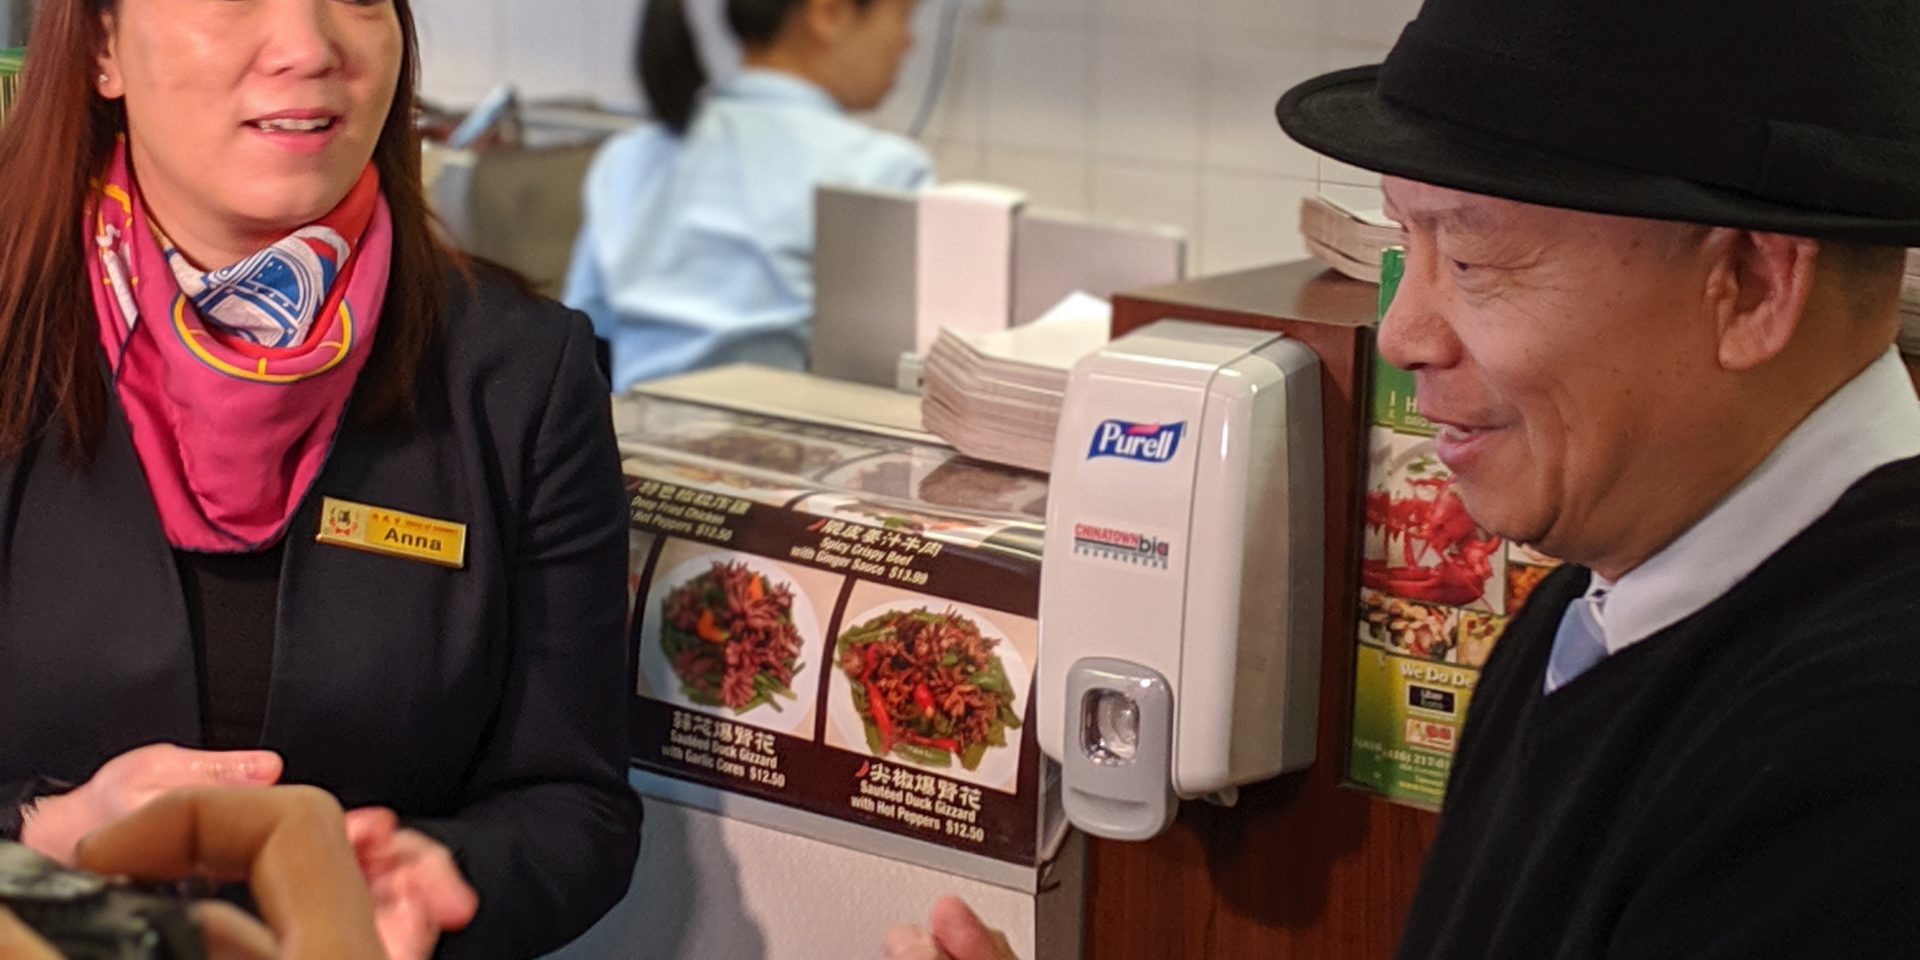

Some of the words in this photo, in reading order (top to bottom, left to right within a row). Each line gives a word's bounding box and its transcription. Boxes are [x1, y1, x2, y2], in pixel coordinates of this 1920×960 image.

[1099, 422, 1174, 460] Purell
[631, 495, 654, 512] Deep
[656, 501, 684, 517] Fried
[684, 508, 725, 525] Chicken
[384, 527, 442, 551] Anna
[632, 511, 650, 525] Hot
[651, 515, 692, 533] Peppers
[695, 523, 733, 541] $12.50
[1075, 523, 1138, 547] CHINATOWN
[789, 545, 816, 561] with
[815, 550, 851, 569] Ginger
[851, 557, 886, 575] Sauce
[888, 566, 929, 586] $13.99
[819, 536, 850, 554] Spicy
[850, 543, 886, 562] Crispy
[886, 551, 915, 567] Beef
[1401, 663, 1423, 679] We
[1426, 666, 1448, 684] Do
[661, 743, 683, 759] with
[685, 749, 714, 768] Garlic
[716, 757, 745, 777] Cores
[750, 766, 786, 788] $12.50
[712, 740, 737, 759] Duck
[739, 747, 777, 769] Gizzard
[851, 796, 875, 813] with
[876, 802, 896, 819] Hot
[897, 806, 941, 831] Peppers
[945, 819, 985, 843] $12.50
[905, 791, 933, 812] Duck
[934, 801, 976, 823] Gizzard
